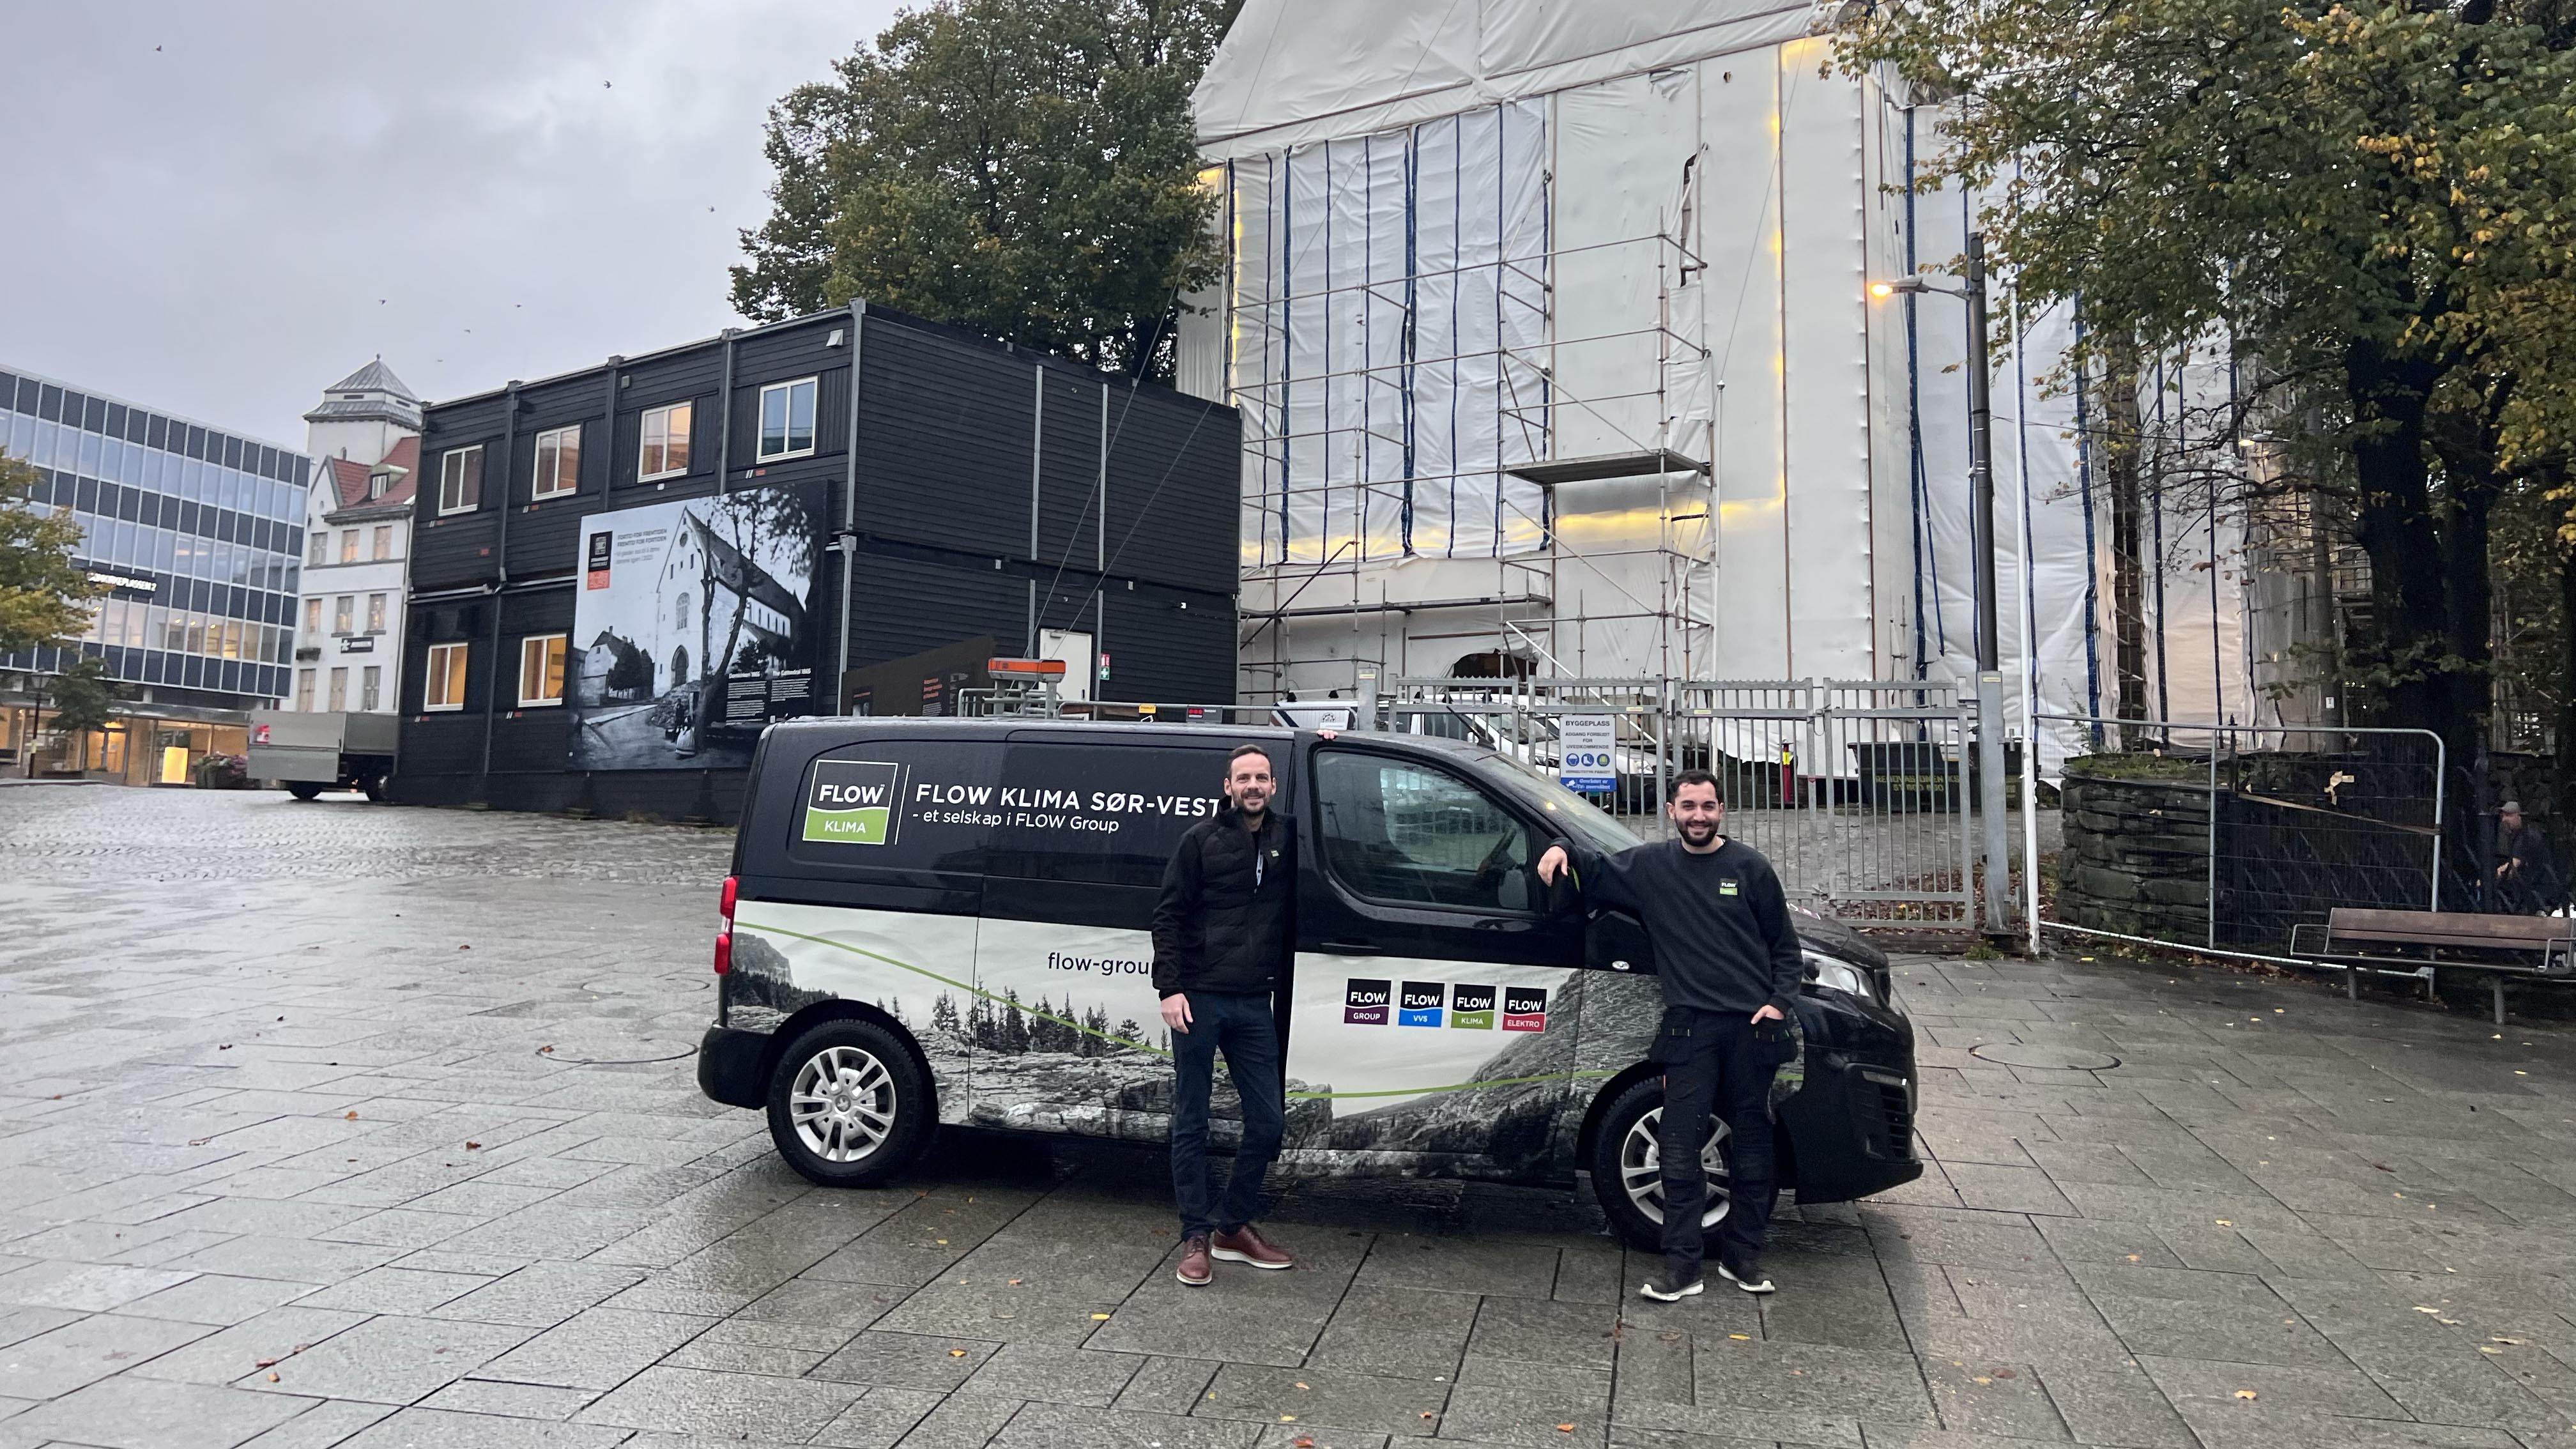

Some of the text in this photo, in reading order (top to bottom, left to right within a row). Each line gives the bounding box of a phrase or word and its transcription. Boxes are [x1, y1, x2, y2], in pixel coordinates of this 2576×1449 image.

[151, 583, 157, 592] 2
[818, 783, 884, 804] FLOW
[916, 783, 1220, 818] FLOW KLIMA SØR-VEST
[824, 820, 866, 833] KLIMA
[923, 809, 939, 822] et
[943, 809, 1002, 827] selskap
[1006, 812, 1011, 826] i
[1015, 813, 1066, 829] FLOW
[1070, 815, 1119, 834] Group
[1048, 952, 1153, 976] flow-grou
[1350, 992, 1386, 1003] FLOW
[1404, 994, 1439, 1006] FLOW
[1457, 997, 1492, 1008] FLOW
[1508, 999, 1542, 1011] FLOW
[1353, 1012, 1381, 1020] GROUP
[1507, 1019, 1540, 1027] ELEKTRO
